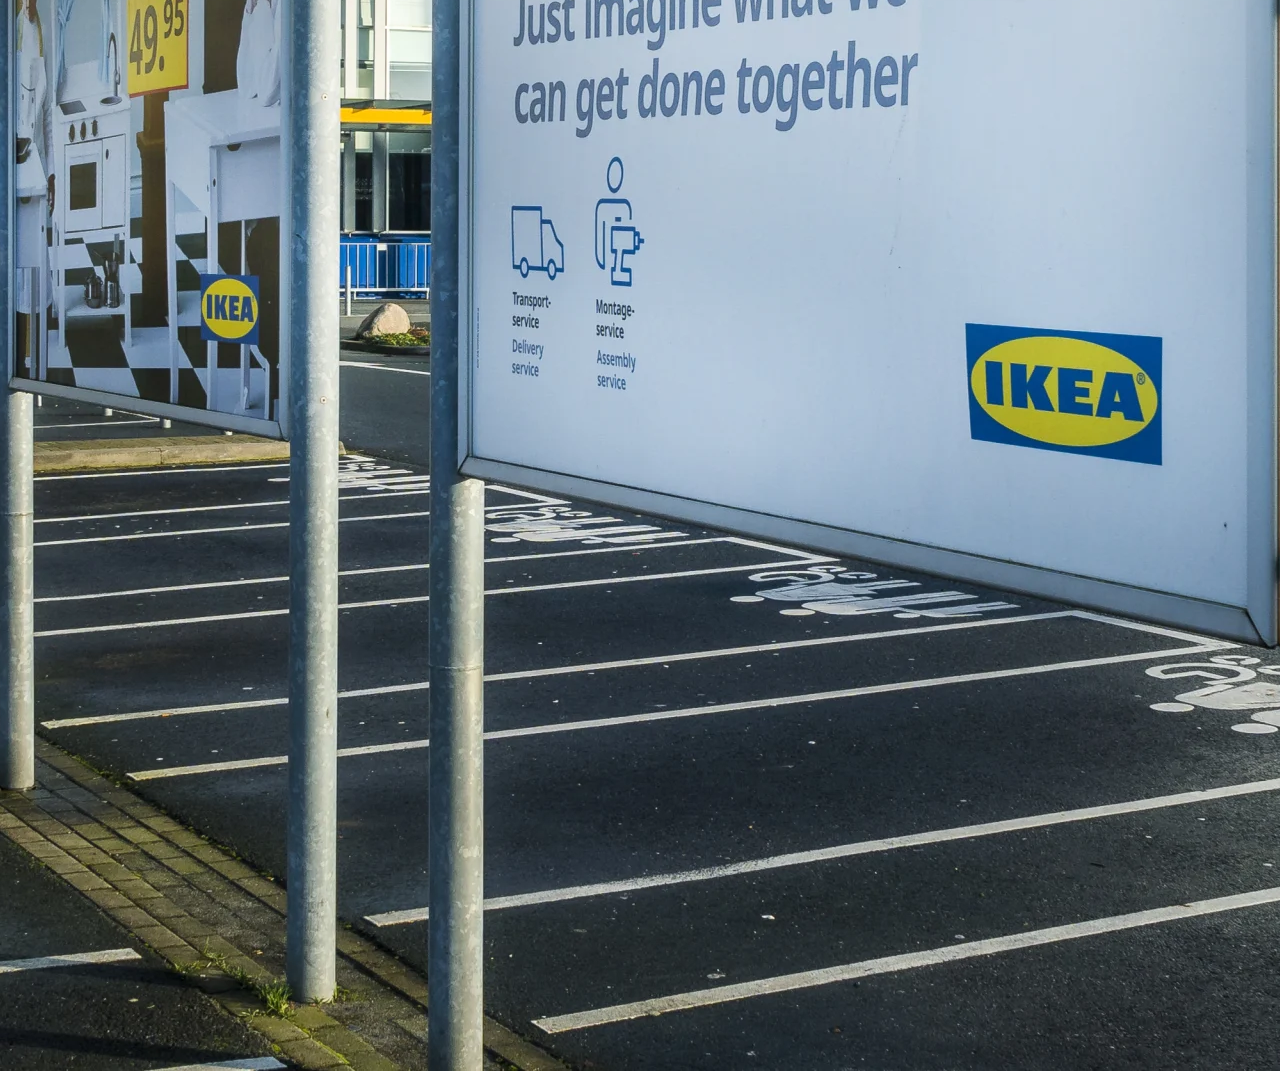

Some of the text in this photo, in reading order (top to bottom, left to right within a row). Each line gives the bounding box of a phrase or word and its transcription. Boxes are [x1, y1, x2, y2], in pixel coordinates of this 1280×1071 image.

[515, 40, 919, 138] can get done together
[207, 294, 254, 322] IKEA
[512, 292, 551, 311] Transport-
[596, 299, 635, 320] Montage-
[512, 314, 539, 329] service
[596, 323, 624, 339] service
[512, 339, 544, 360] Delivery
[512, 362, 539, 377] service
[597, 350, 636, 373] Assembly
[597, 374, 626, 390] service
[985, 360, 1145, 422] IKEA
